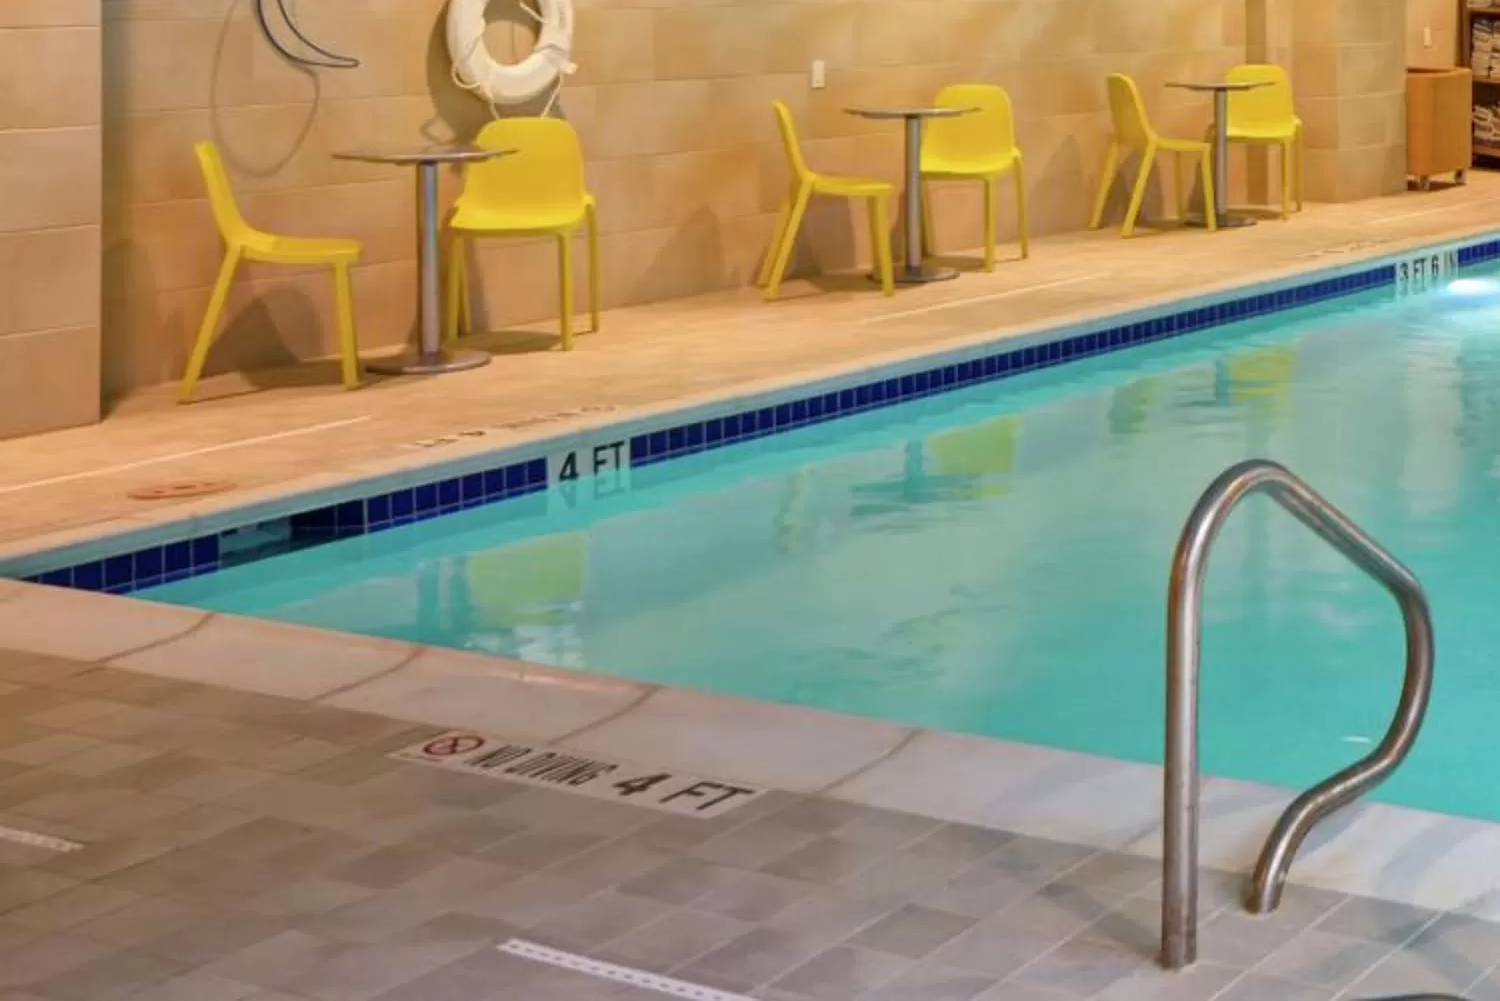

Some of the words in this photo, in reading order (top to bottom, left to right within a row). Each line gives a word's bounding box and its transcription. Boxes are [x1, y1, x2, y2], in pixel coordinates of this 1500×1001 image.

[558, 451, 579, 482] 4
[593, 440, 624, 475] FT
[612, 773, 672, 796] 4
[657, 780, 755, 812] FT
